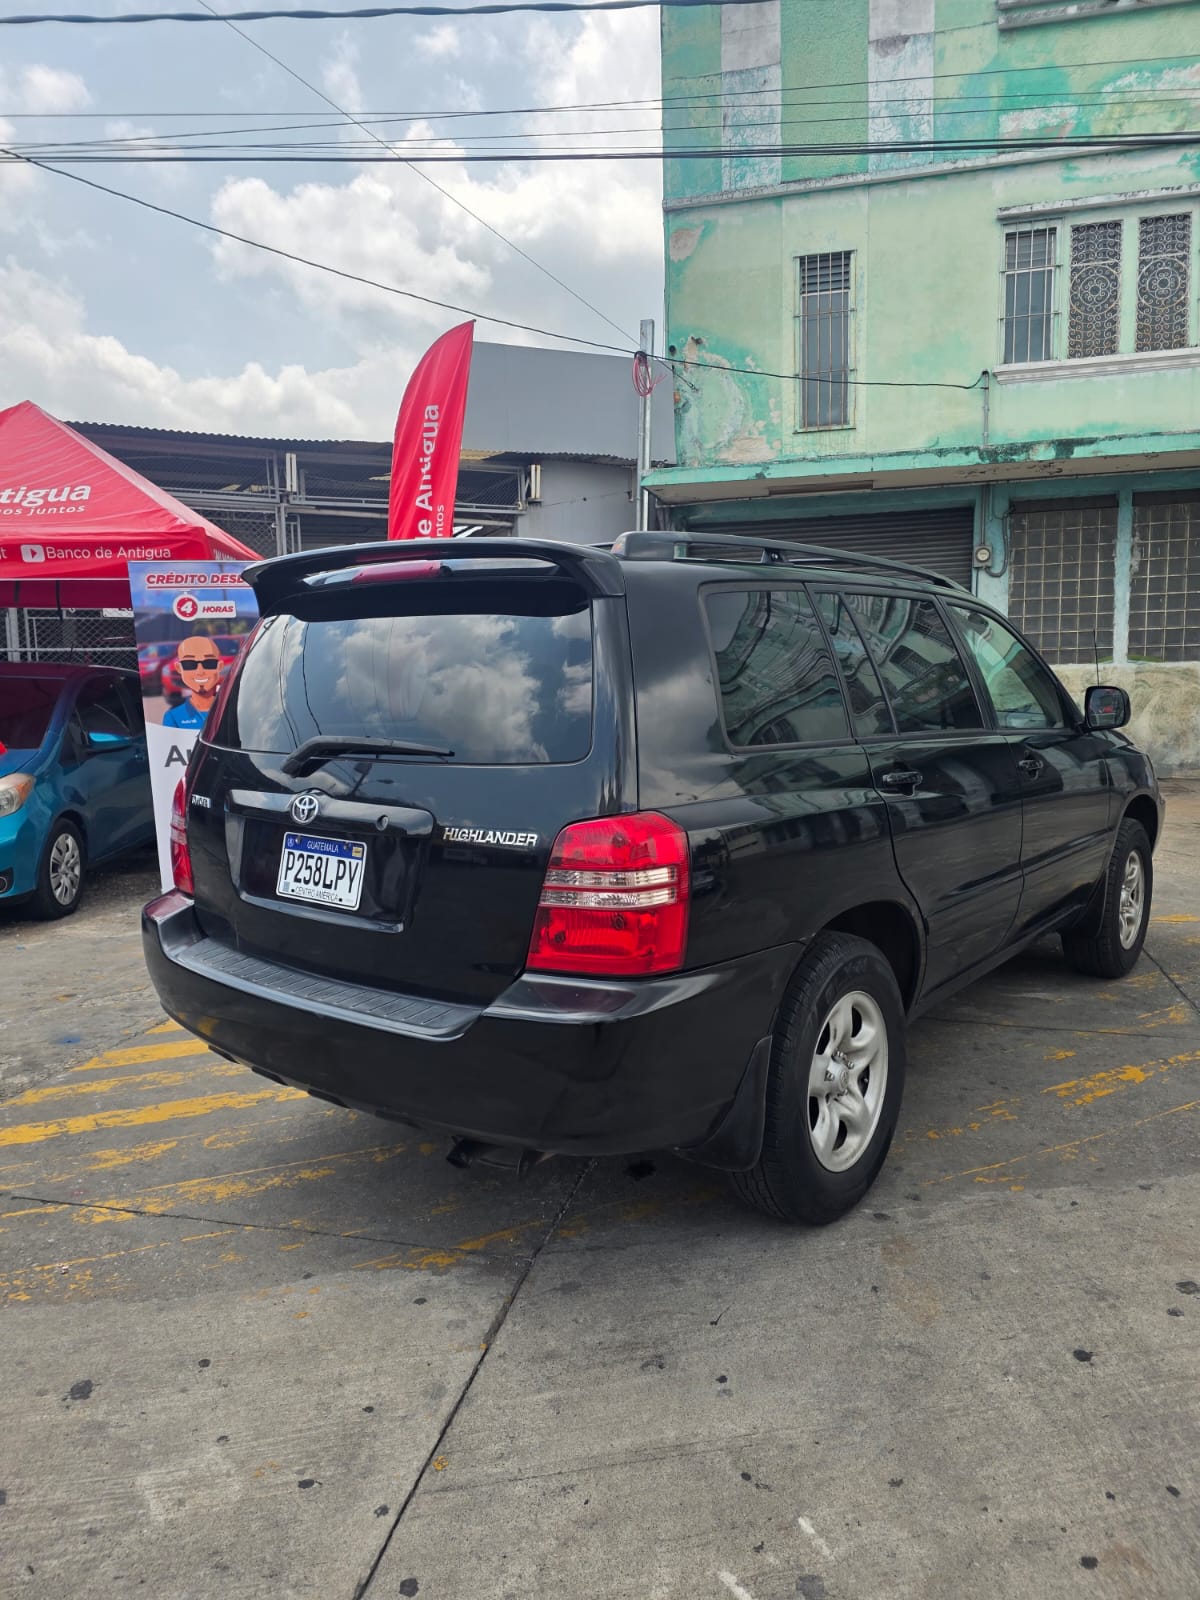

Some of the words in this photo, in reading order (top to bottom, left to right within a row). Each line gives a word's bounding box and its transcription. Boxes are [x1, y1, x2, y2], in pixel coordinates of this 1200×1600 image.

[27, 505, 86, 517] juntos
[46, 546, 91, 560] Banco
[95, 548, 113, 559] de
[117, 546, 171, 560] Antigua
[146, 571, 208, 585] CRÉDITO
[180, 601, 193, 614] 4
[202, 605, 234, 614] HORAS
[443, 827, 538, 847] HIGHLANDER
[306, 840, 339, 853] GUATEMALA
[284, 850, 359, 894] P258LPY
